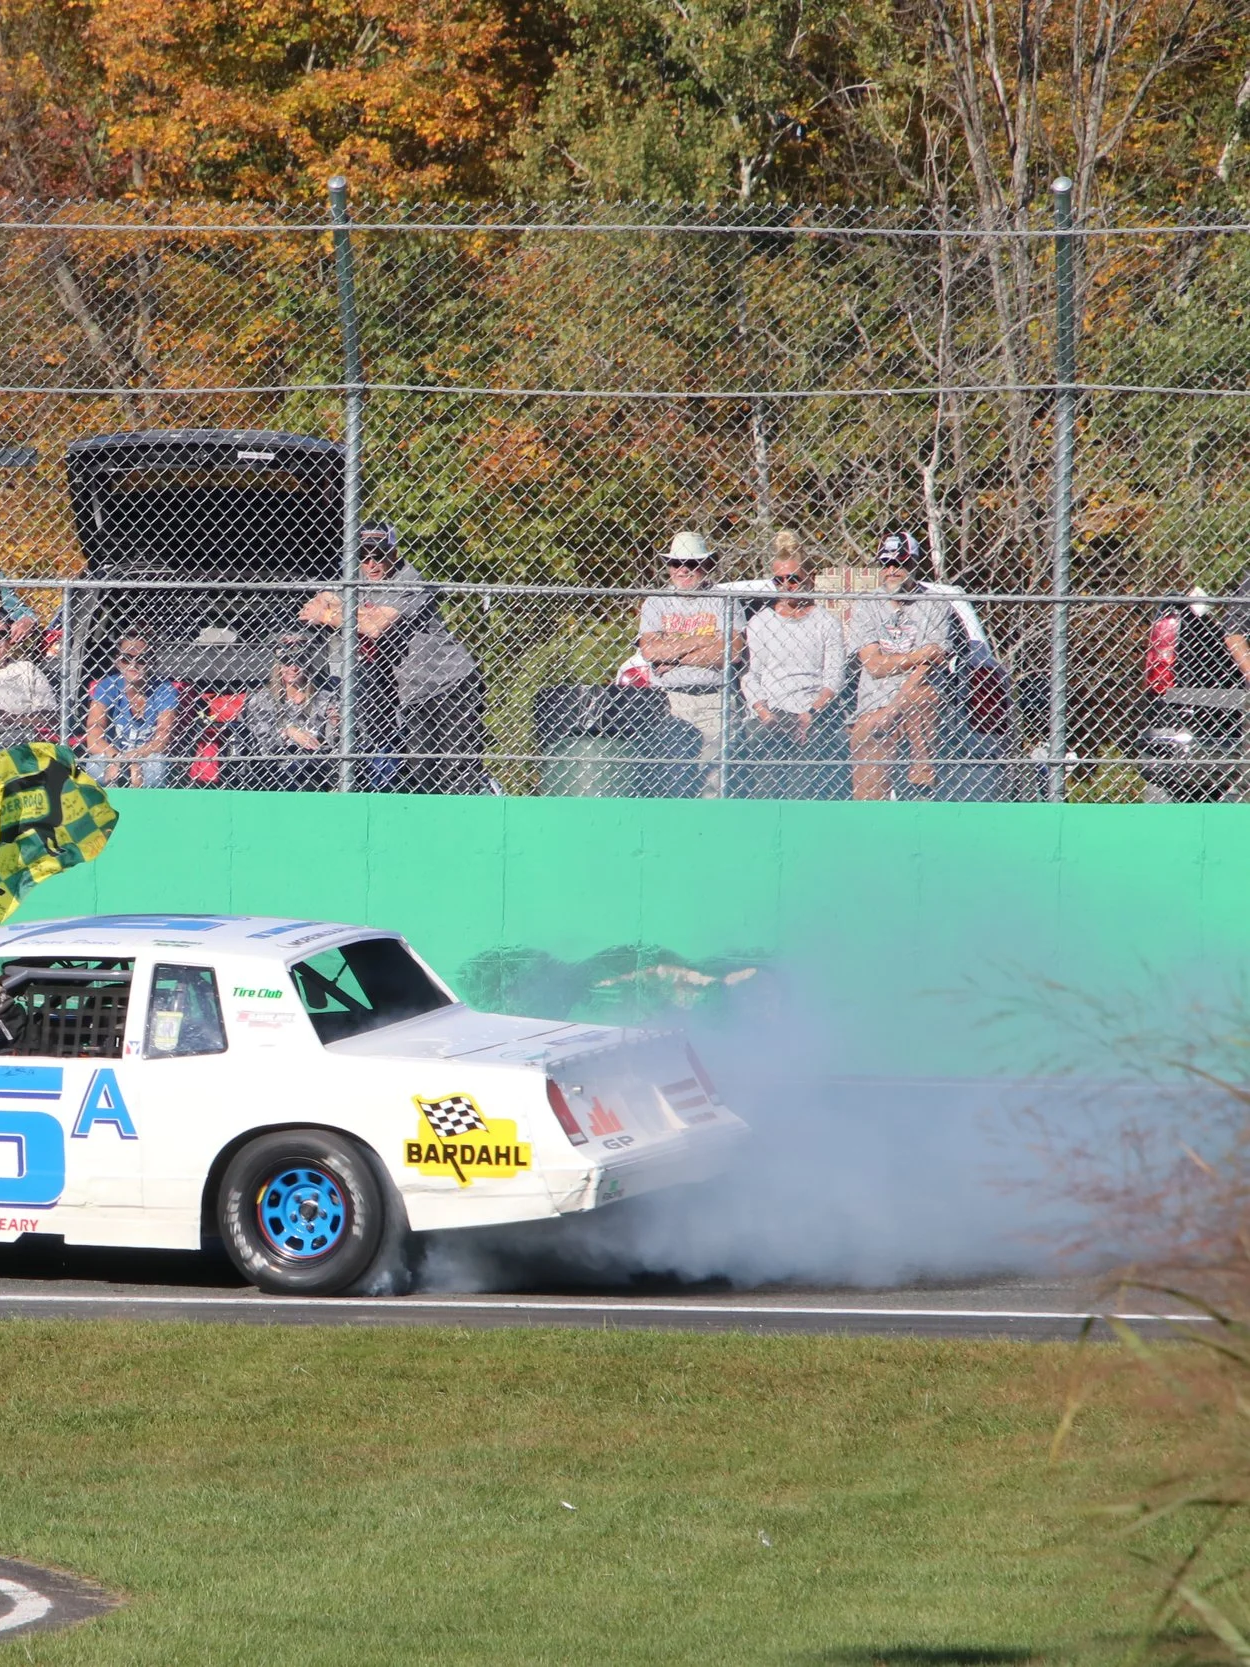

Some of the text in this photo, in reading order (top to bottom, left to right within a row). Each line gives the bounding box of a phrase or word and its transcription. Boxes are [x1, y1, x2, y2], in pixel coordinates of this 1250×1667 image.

[233, 987, 283, 998] Tire Club
[70, 1068, 138, 1140] A
[602, 1135, 635, 1150] GP
[407, 1143, 527, 1166] BARDAHL
